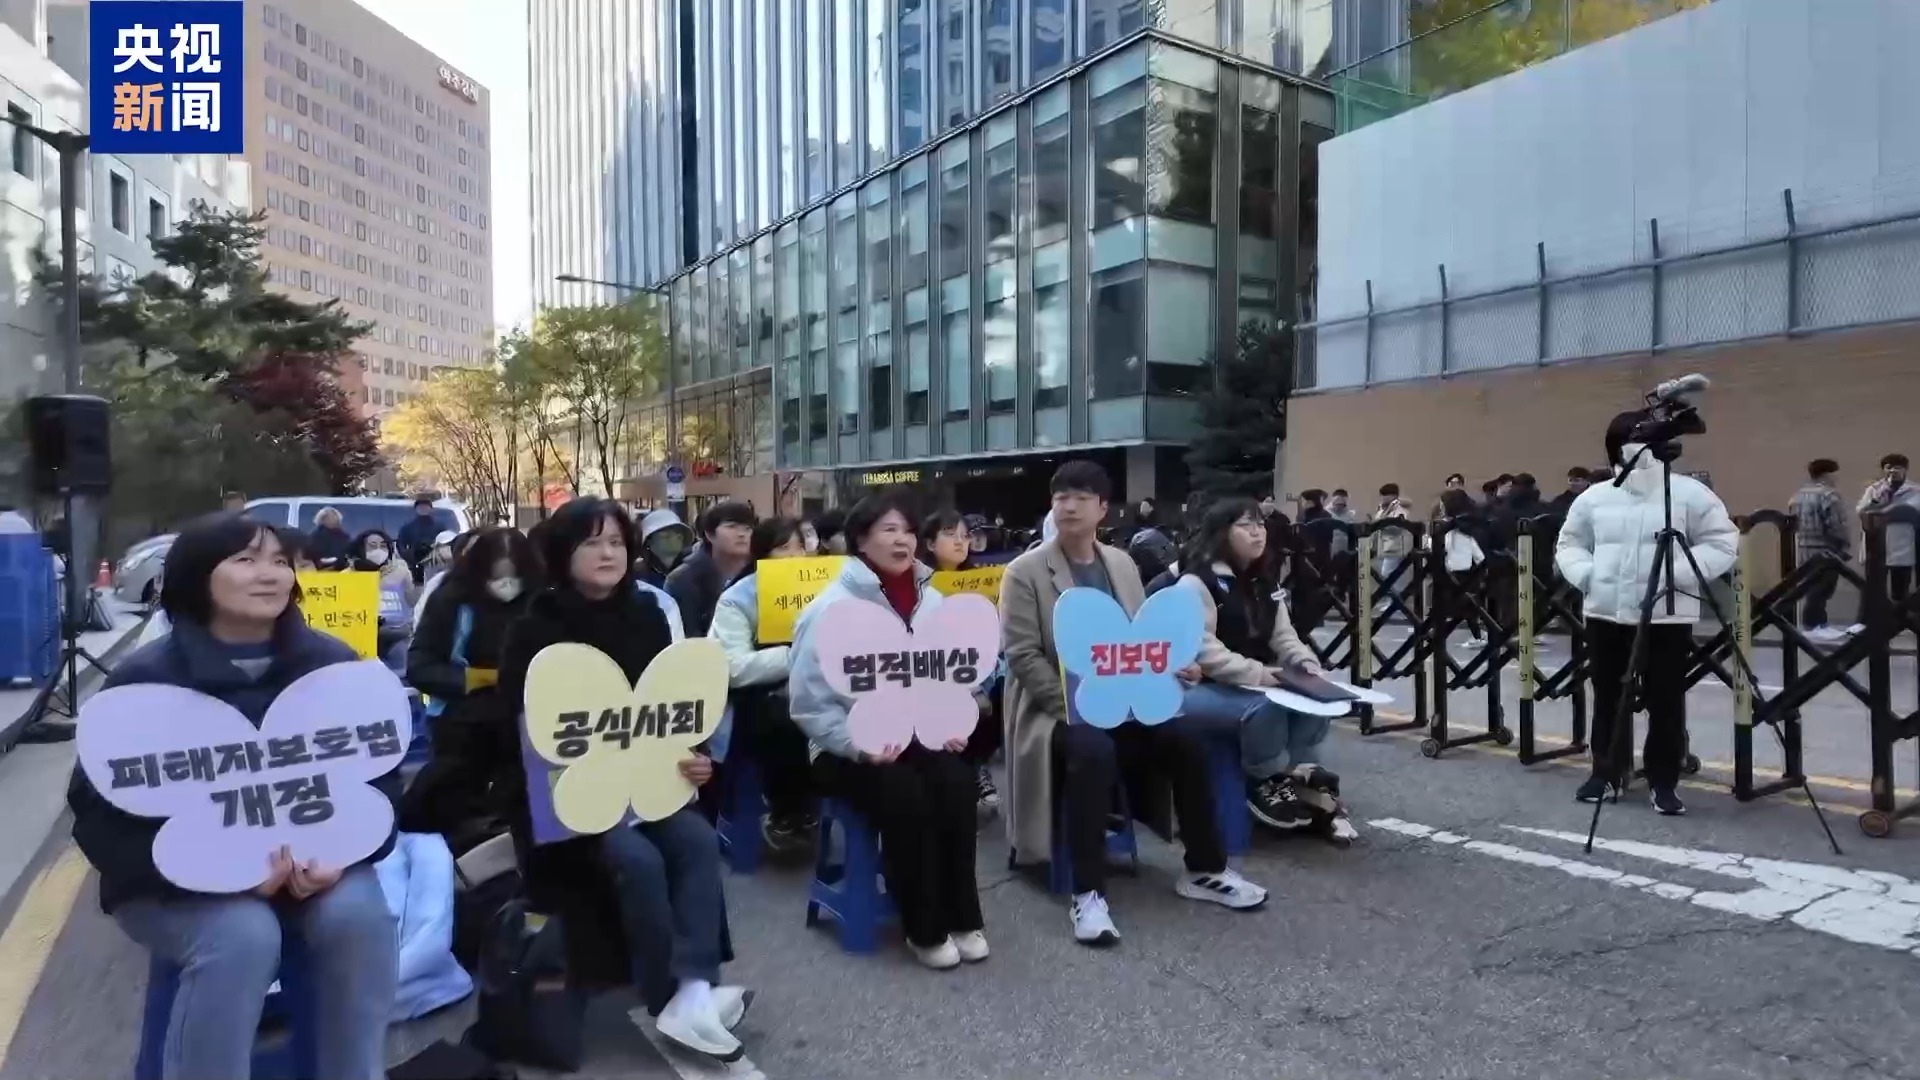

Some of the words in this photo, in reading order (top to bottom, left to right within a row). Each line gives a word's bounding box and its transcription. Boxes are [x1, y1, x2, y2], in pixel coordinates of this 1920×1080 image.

[895, 470, 920, 483] COFFEE
[800, 567, 829, 581] 11.25
[1733, 568, 1745, 642] POLICE
[843, 647, 980, 693] 법적배상
[1091, 641, 1172, 676] 진보당
[107, 719, 402, 789] 피해자보호법
[553, 699, 704, 758] 공식사죄
[210, 773, 334, 829] 개정
